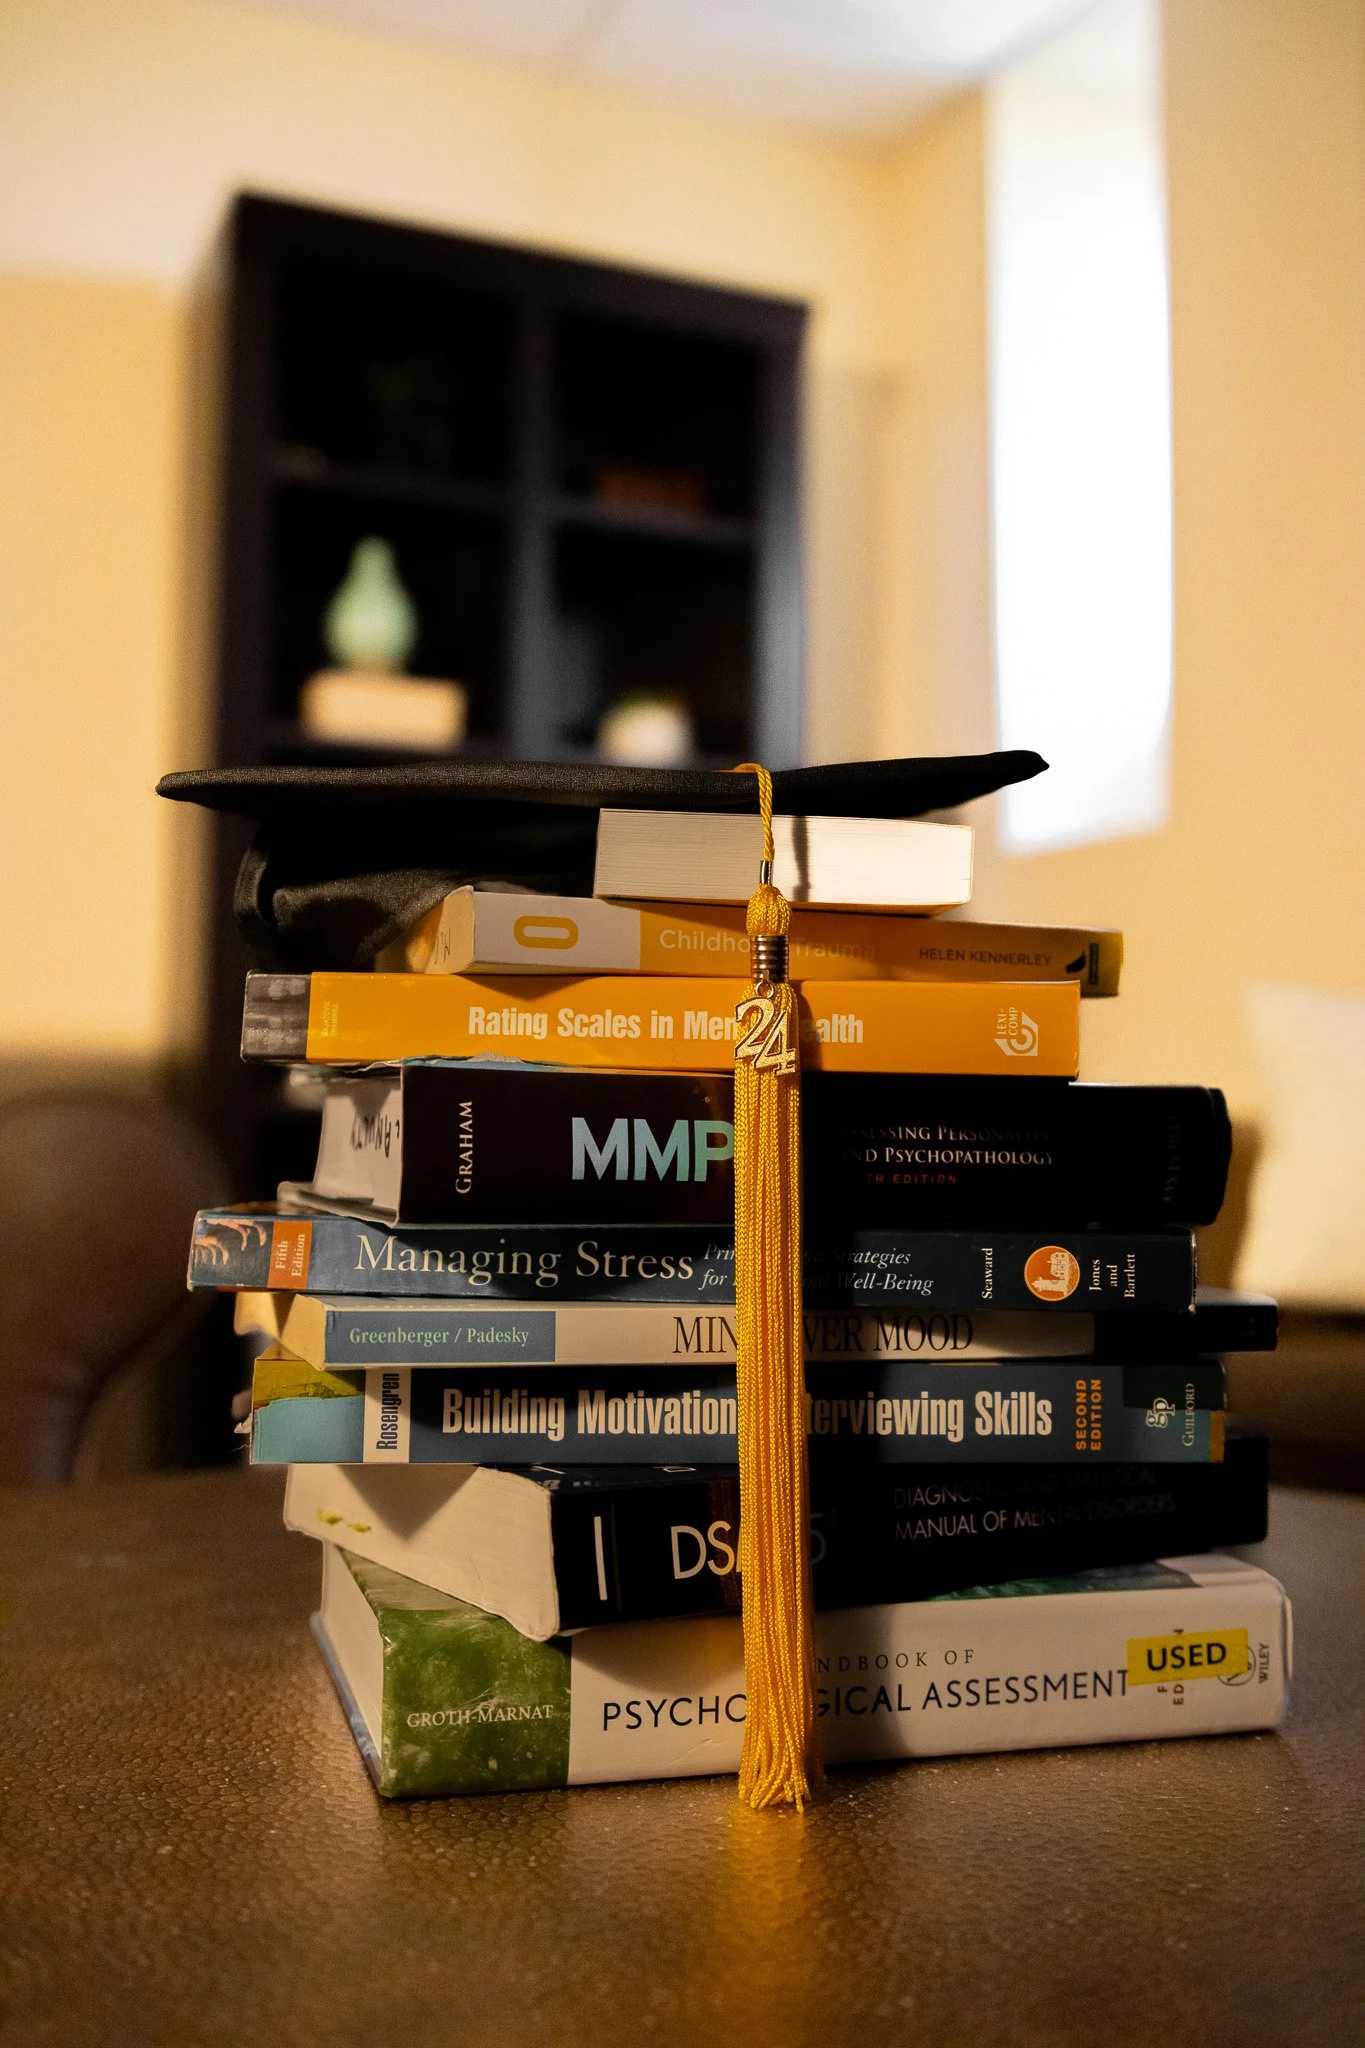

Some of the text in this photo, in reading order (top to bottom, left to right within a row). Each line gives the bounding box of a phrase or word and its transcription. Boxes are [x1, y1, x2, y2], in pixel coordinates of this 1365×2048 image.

[659, 928, 751, 952] Childho
[919, 947, 1052, 966] HELEN KENNERLEY
[468, 1006, 548, 1040] Rating
[558, 1008, 641, 1040] Scales
[650, 1010, 673, 1041] in
[801, 1013, 864, 1043] ealth
[734, 997, 796, 1076] 24
[1008, 1006, 1019, 1036] COMP
[455, 1101, 474, 1194] GRAHAM
[885, 1146, 1055, 1166] PSYCHOPATHOLOGY
[893, 1173, 958, 1186] EDITION
[275, 1239, 288, 1270] Fifth
[290, 1233, 306, 1278] Edition
[354, 1234, 694, 1285] Managing Stress
[831, 1247, 912, 1270] Strategies
[698, 1268, 727, 1290] for
[837, 1272, 935, 1296] Well-Being
[981, 1247, 994, 1299] Seaward
[1089, 1258, 1101, 1292] Jones
[1108, 1263, 1118, 1287] and
[1123, 1253, 1136, 1299] Bartlett
[349, 1325, 449, 1349] Greenberger
[467, 1325, 530, 1348] Padesky
[672, 1313, 974, 1354] MIN VER MOOD
[376, 1373, 402, 1450] Rosengren
[443, 1388, 1053, 1443] Building Motivation terviewing Skills
[1075, 1379, 1087, 1451] SECOND
[1090, 1378, 1102, 1451] EDITION
[1182, 1382, 1195, 1447] GUILFORD
[895, 1513, 978, 1542] MANUAL
[982, 1509, 1009, 1533] OF
[817, 1649, 974, 1673] NDBOOK OF
[1147, 1642, 1227, 1672] USED
[1259, 1642, 1271, 1684] WILEY
[922, 1669, 1128, 1709] ASSESSMENT
[406, 1703, 554, 1728] GROTH-MARNAT
